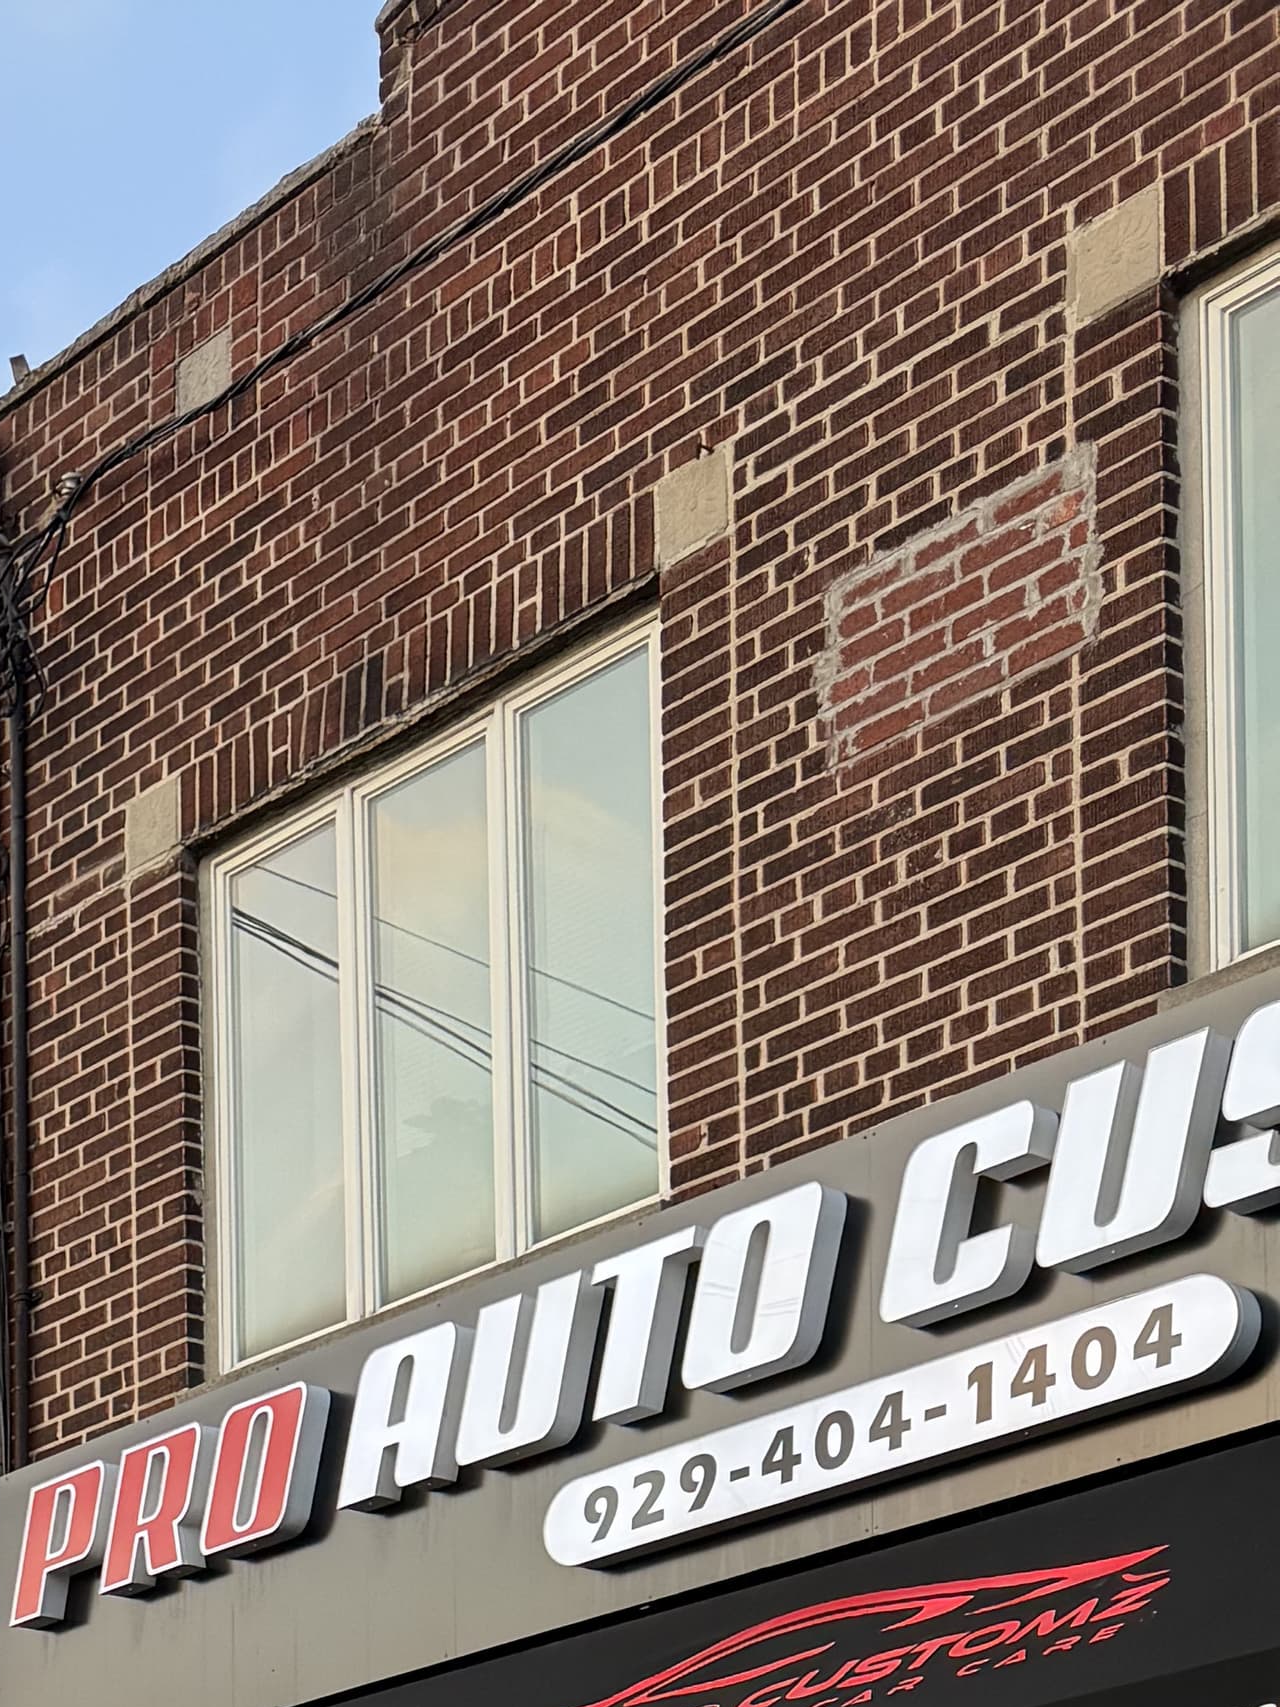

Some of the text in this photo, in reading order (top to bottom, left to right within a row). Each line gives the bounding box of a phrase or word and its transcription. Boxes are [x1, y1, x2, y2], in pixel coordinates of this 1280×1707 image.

[9, 1380, 326, 1628] PRO
[338, 1180, 846, 1512] AUTO
[583, 1303, 1183, 1542] 929-404-1404
[957, 1623, 1125, 1678] CARE
